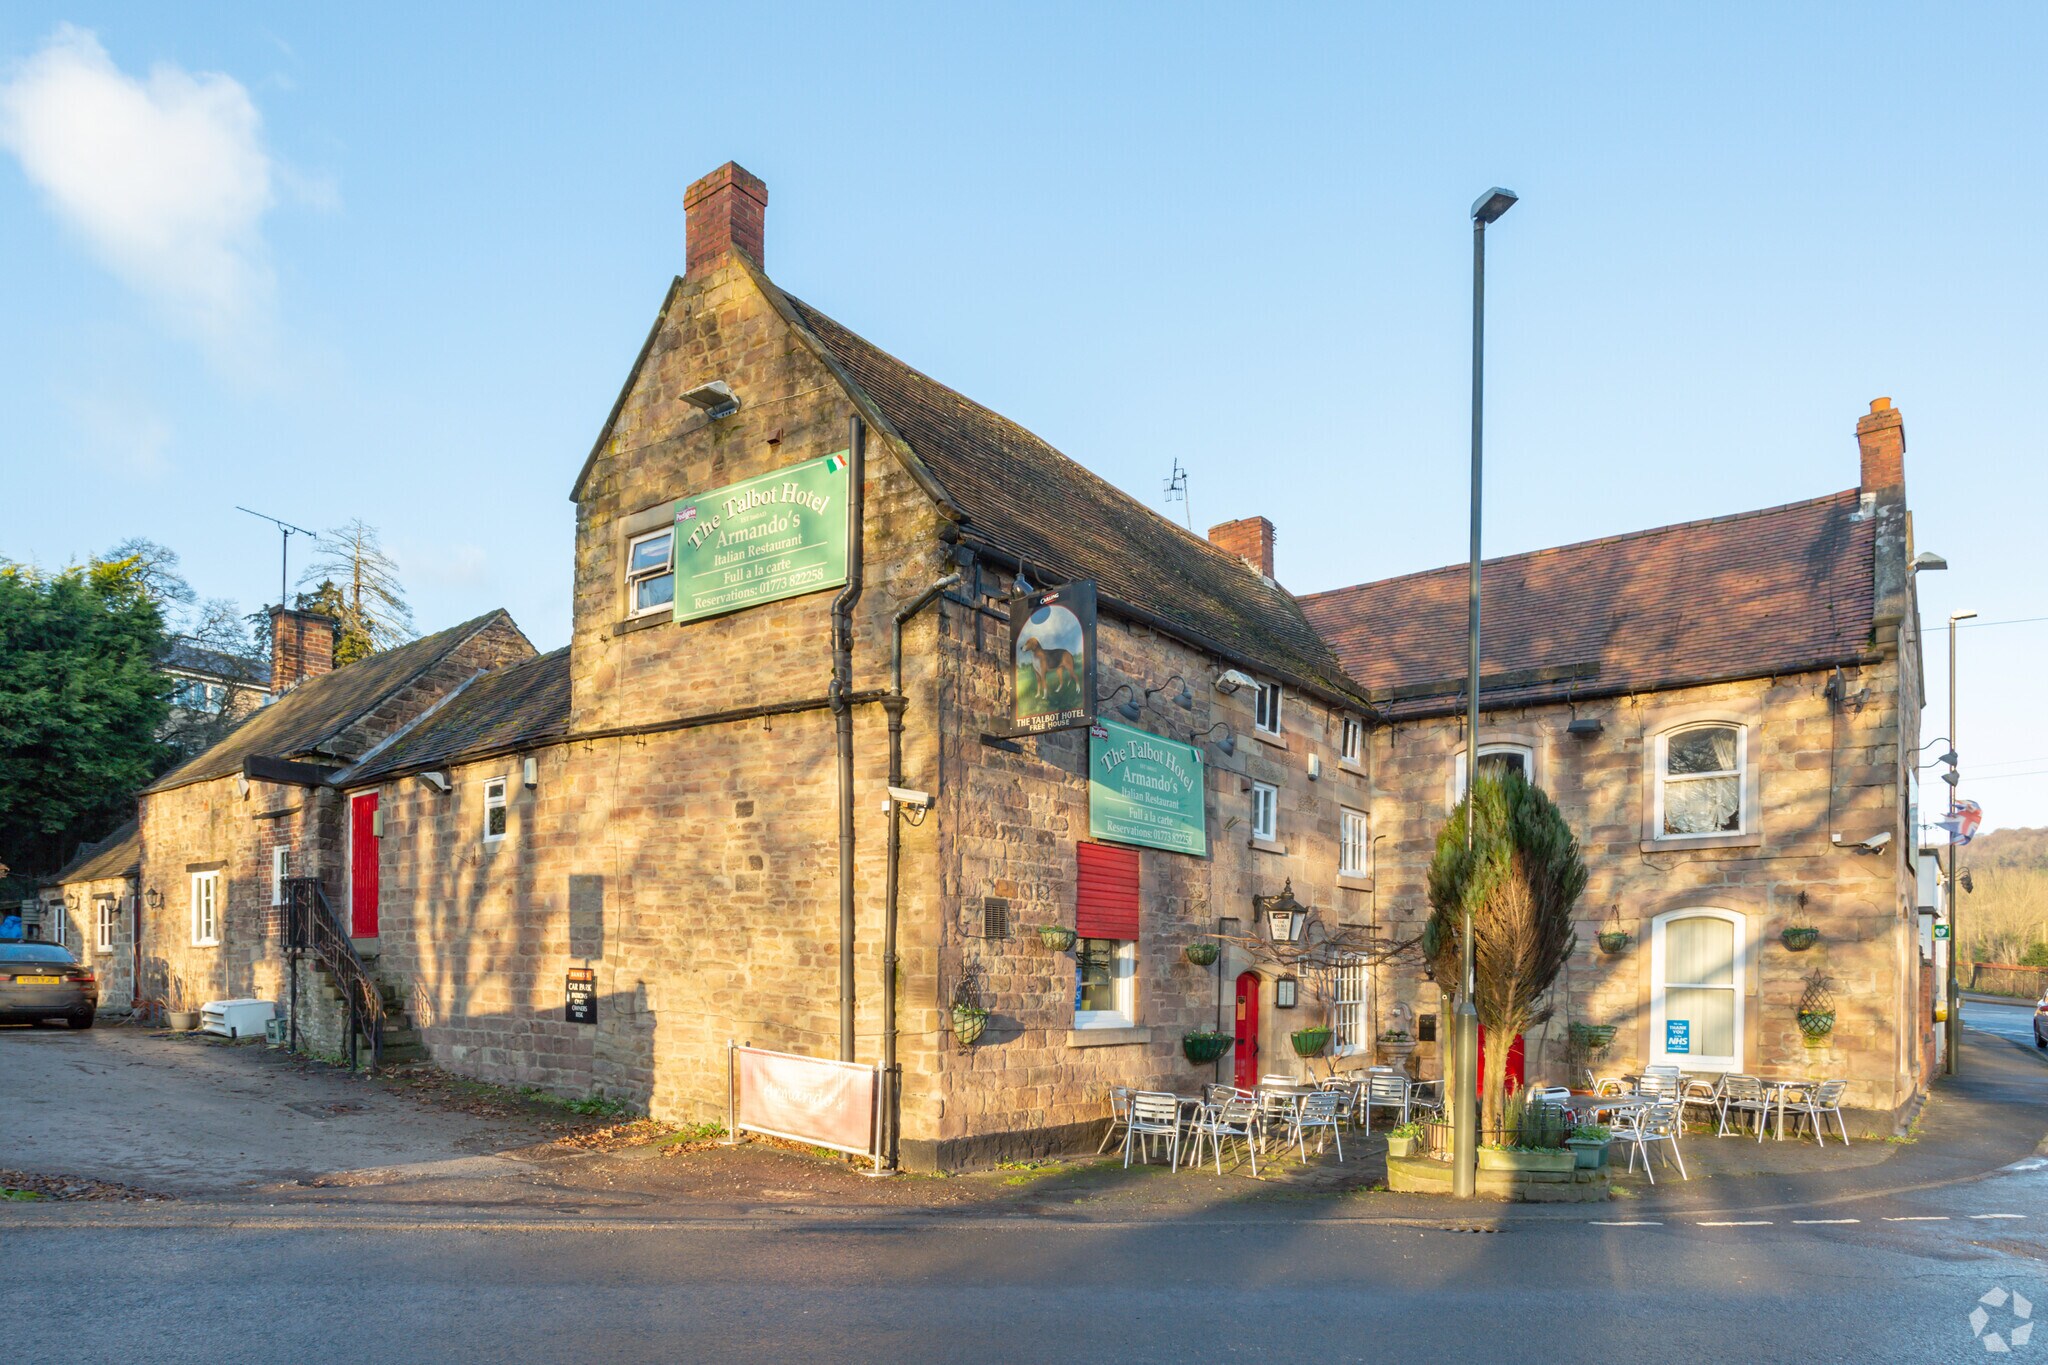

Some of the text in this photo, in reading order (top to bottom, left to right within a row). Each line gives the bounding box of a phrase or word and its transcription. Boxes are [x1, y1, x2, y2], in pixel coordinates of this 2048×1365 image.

[687, 482, 831, 552] The Talbot Hotel
[715, 510, 801, 549] Armando's
[714, 533, 803, 567] Italian Restaurant
[723, 567, 744, 585] Full
[755, 563, 764, 577] la
[766, 558, 792, 573] carte
[694, 567, 824, 610] Reservations: 01773 822258
[1016, 708, 1085, 728] THE TALBOT HOTEL
[1029, 719, 1070, 732] FREE HOUSE
[1101, 740, 1194, 793] The Talbot Hotel
[1122, 765, 1178, 794] Armando's
[1121, 786, 1180, 810] Italian Restaurant
[1129, 806, 1143, 820] Full
[1149, 810, 1156, 823] la
[1158, 815, 1174, 826] carte
[1107, 819, 1193, 846] Reservations: 01773 822258
[568, 982, 592, 992] CAR PARK
[1668, 1037, 1688, 1045] NHS
